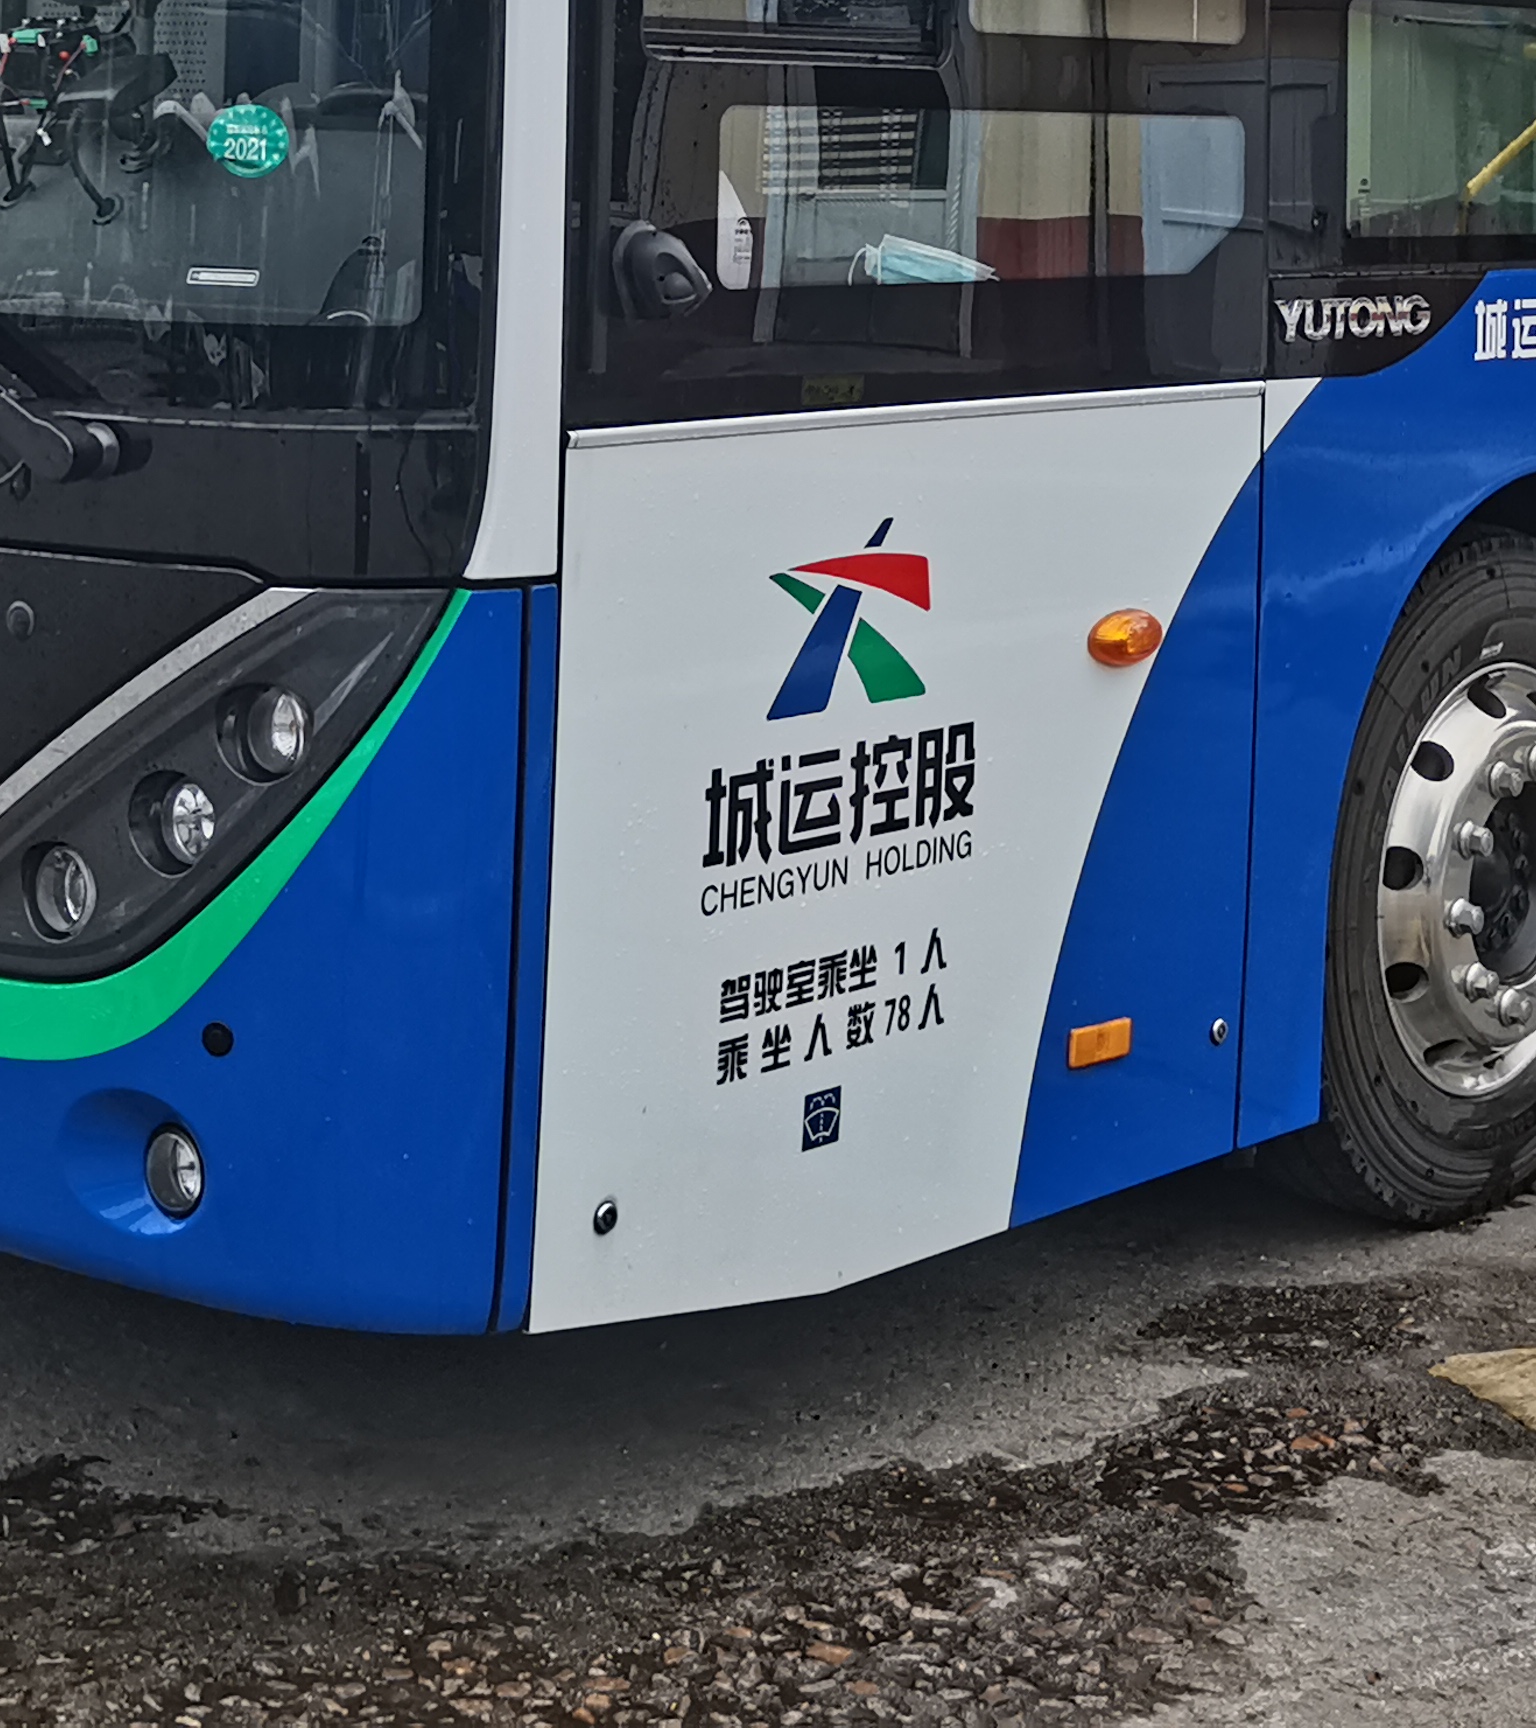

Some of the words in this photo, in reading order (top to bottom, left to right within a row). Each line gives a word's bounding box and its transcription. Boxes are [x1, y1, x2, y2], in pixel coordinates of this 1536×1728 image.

[223, 136, 268, 161] 2021
[1275, 294, 1431, 343] YUTONG
[702, 721, 976, 868] 城运控股
[700, 855, 849, 917] CHENGYUN
[866, 829, 972, 881] HOLDING
